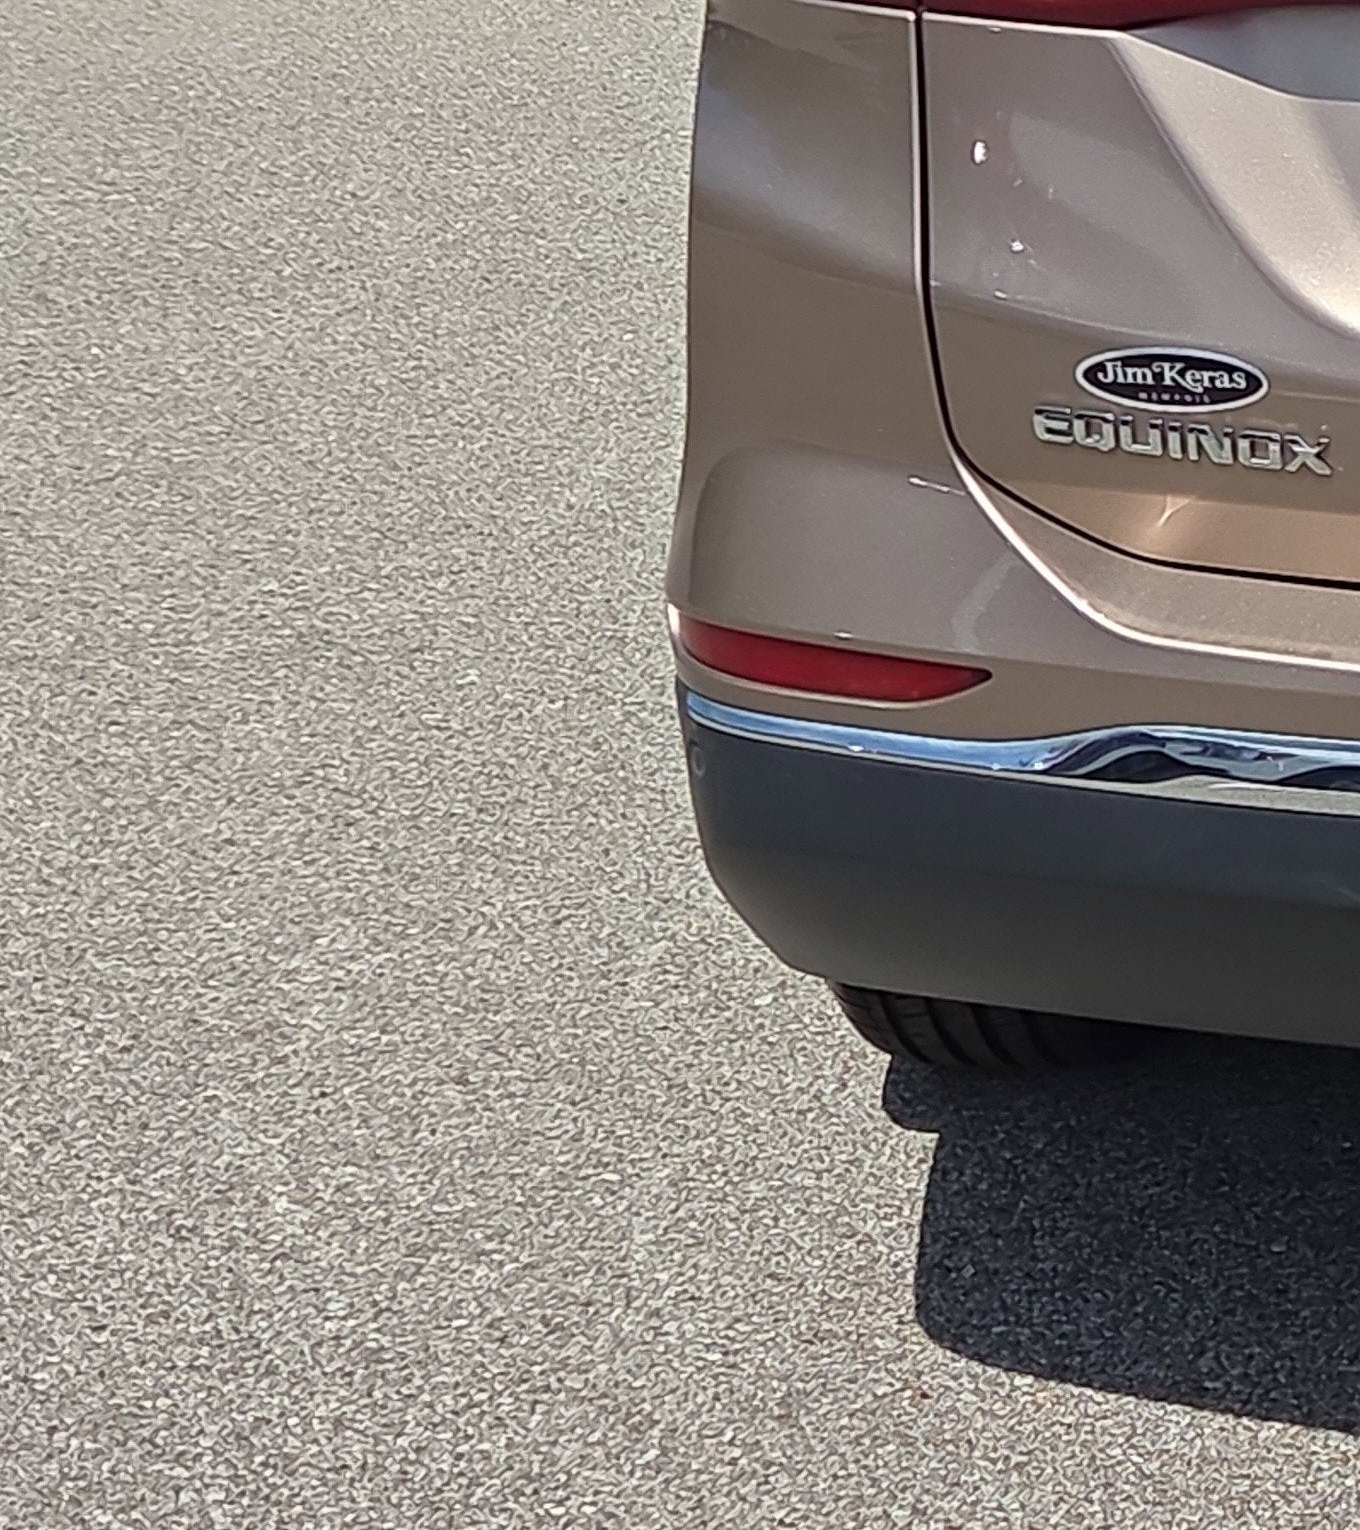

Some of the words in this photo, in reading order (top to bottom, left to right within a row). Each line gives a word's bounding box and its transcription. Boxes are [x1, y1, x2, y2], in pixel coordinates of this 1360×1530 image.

[1097, 360, 1160, 385] Jim
[1152, 362, 1248, 392] Keras
[1032, 405, 1333, 476] EQUINOX
